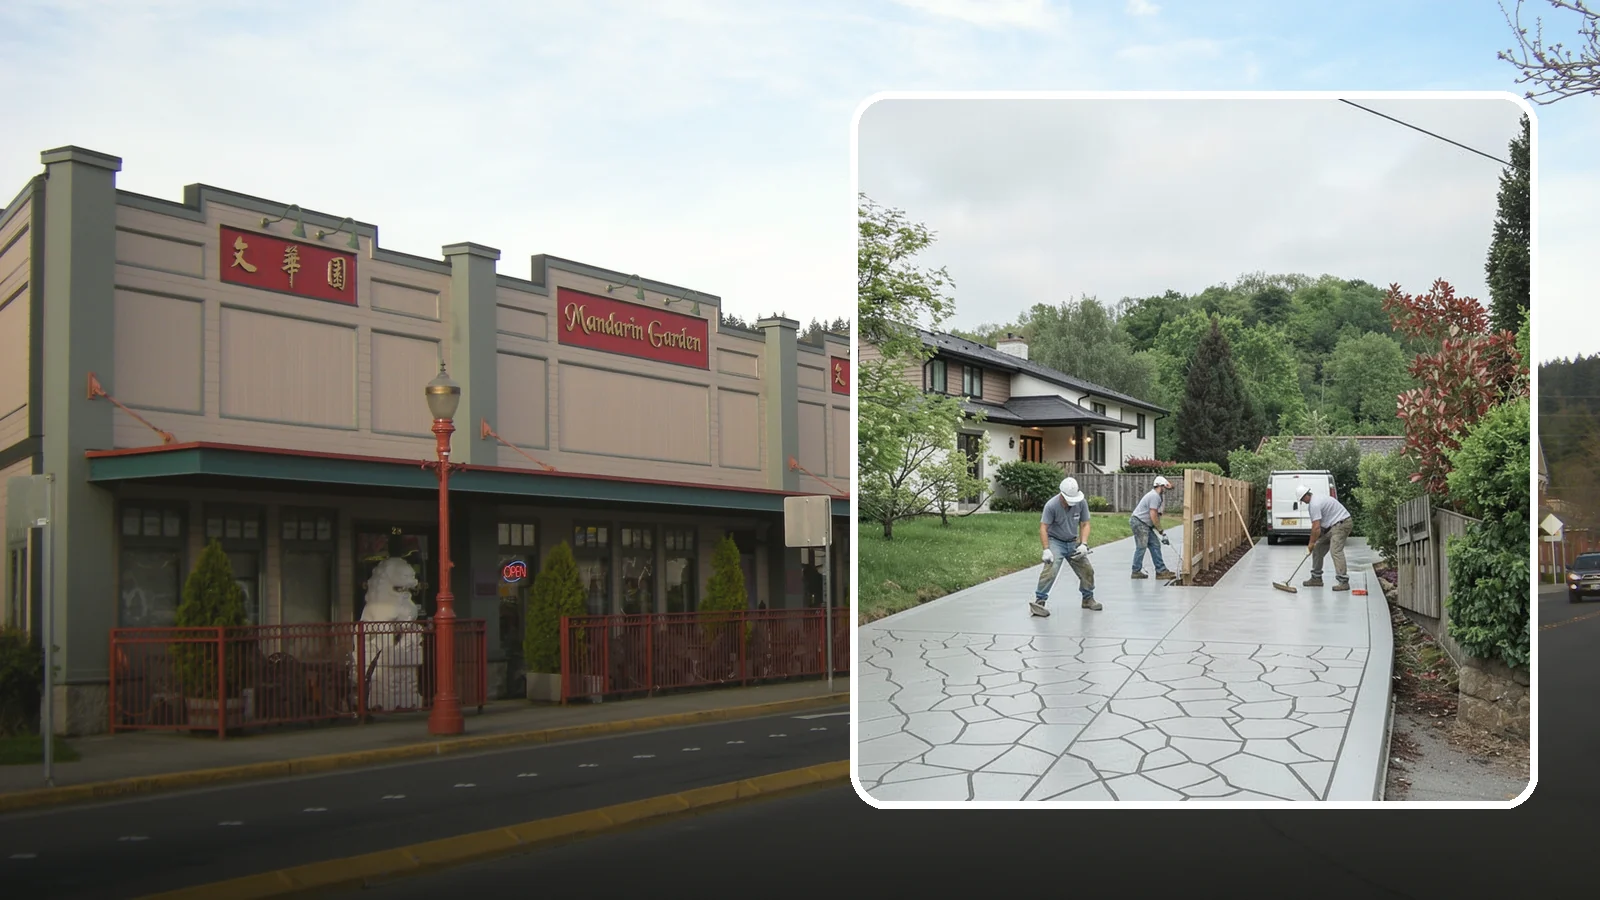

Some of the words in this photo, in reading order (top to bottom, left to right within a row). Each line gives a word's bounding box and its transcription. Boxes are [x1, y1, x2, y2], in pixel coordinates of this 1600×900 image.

[231, 236, 346, 291] 文華園
[564, 302, 644, 341] Mandarin
[648, 320, 702, 352] Garden
[503, 565, 526, 578] OPEN
